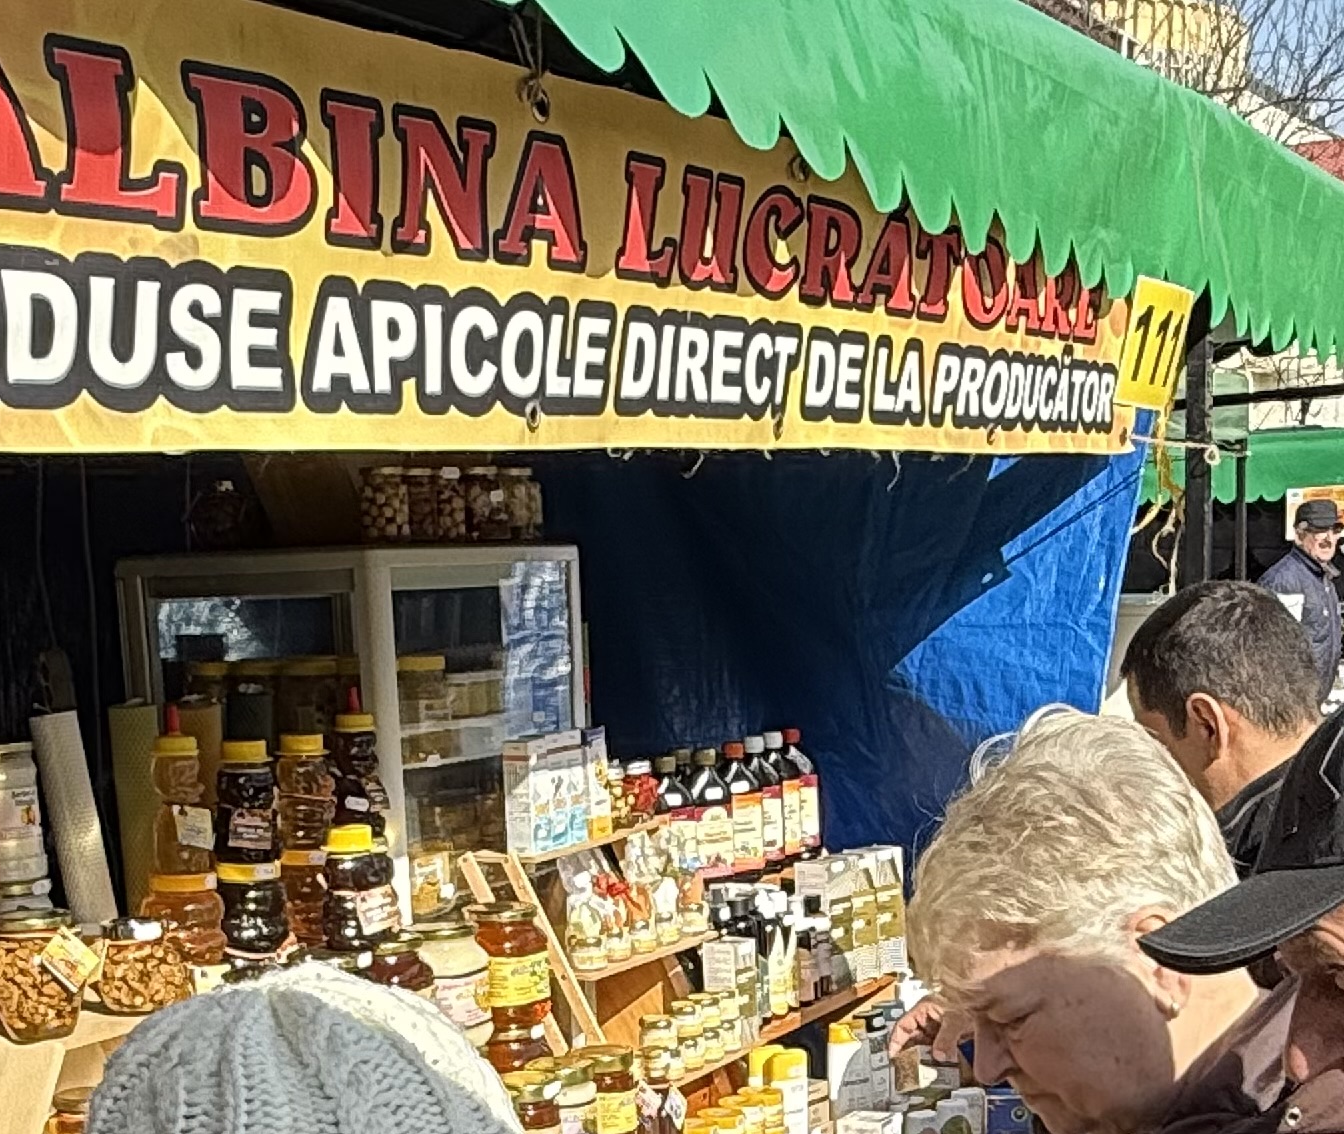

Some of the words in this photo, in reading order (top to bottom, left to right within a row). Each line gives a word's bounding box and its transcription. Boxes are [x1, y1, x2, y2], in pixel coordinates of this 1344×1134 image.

[309, 290, 610, 404] APICOLE
[623, 318, 796, 412] DIRECT
[803, 336, 867, 416] DE
[872, 343, 924, 417] LA
[932, 350, 1117, 424] PRODUCĂTOR
[1132, 311, 1185, 389] 111
